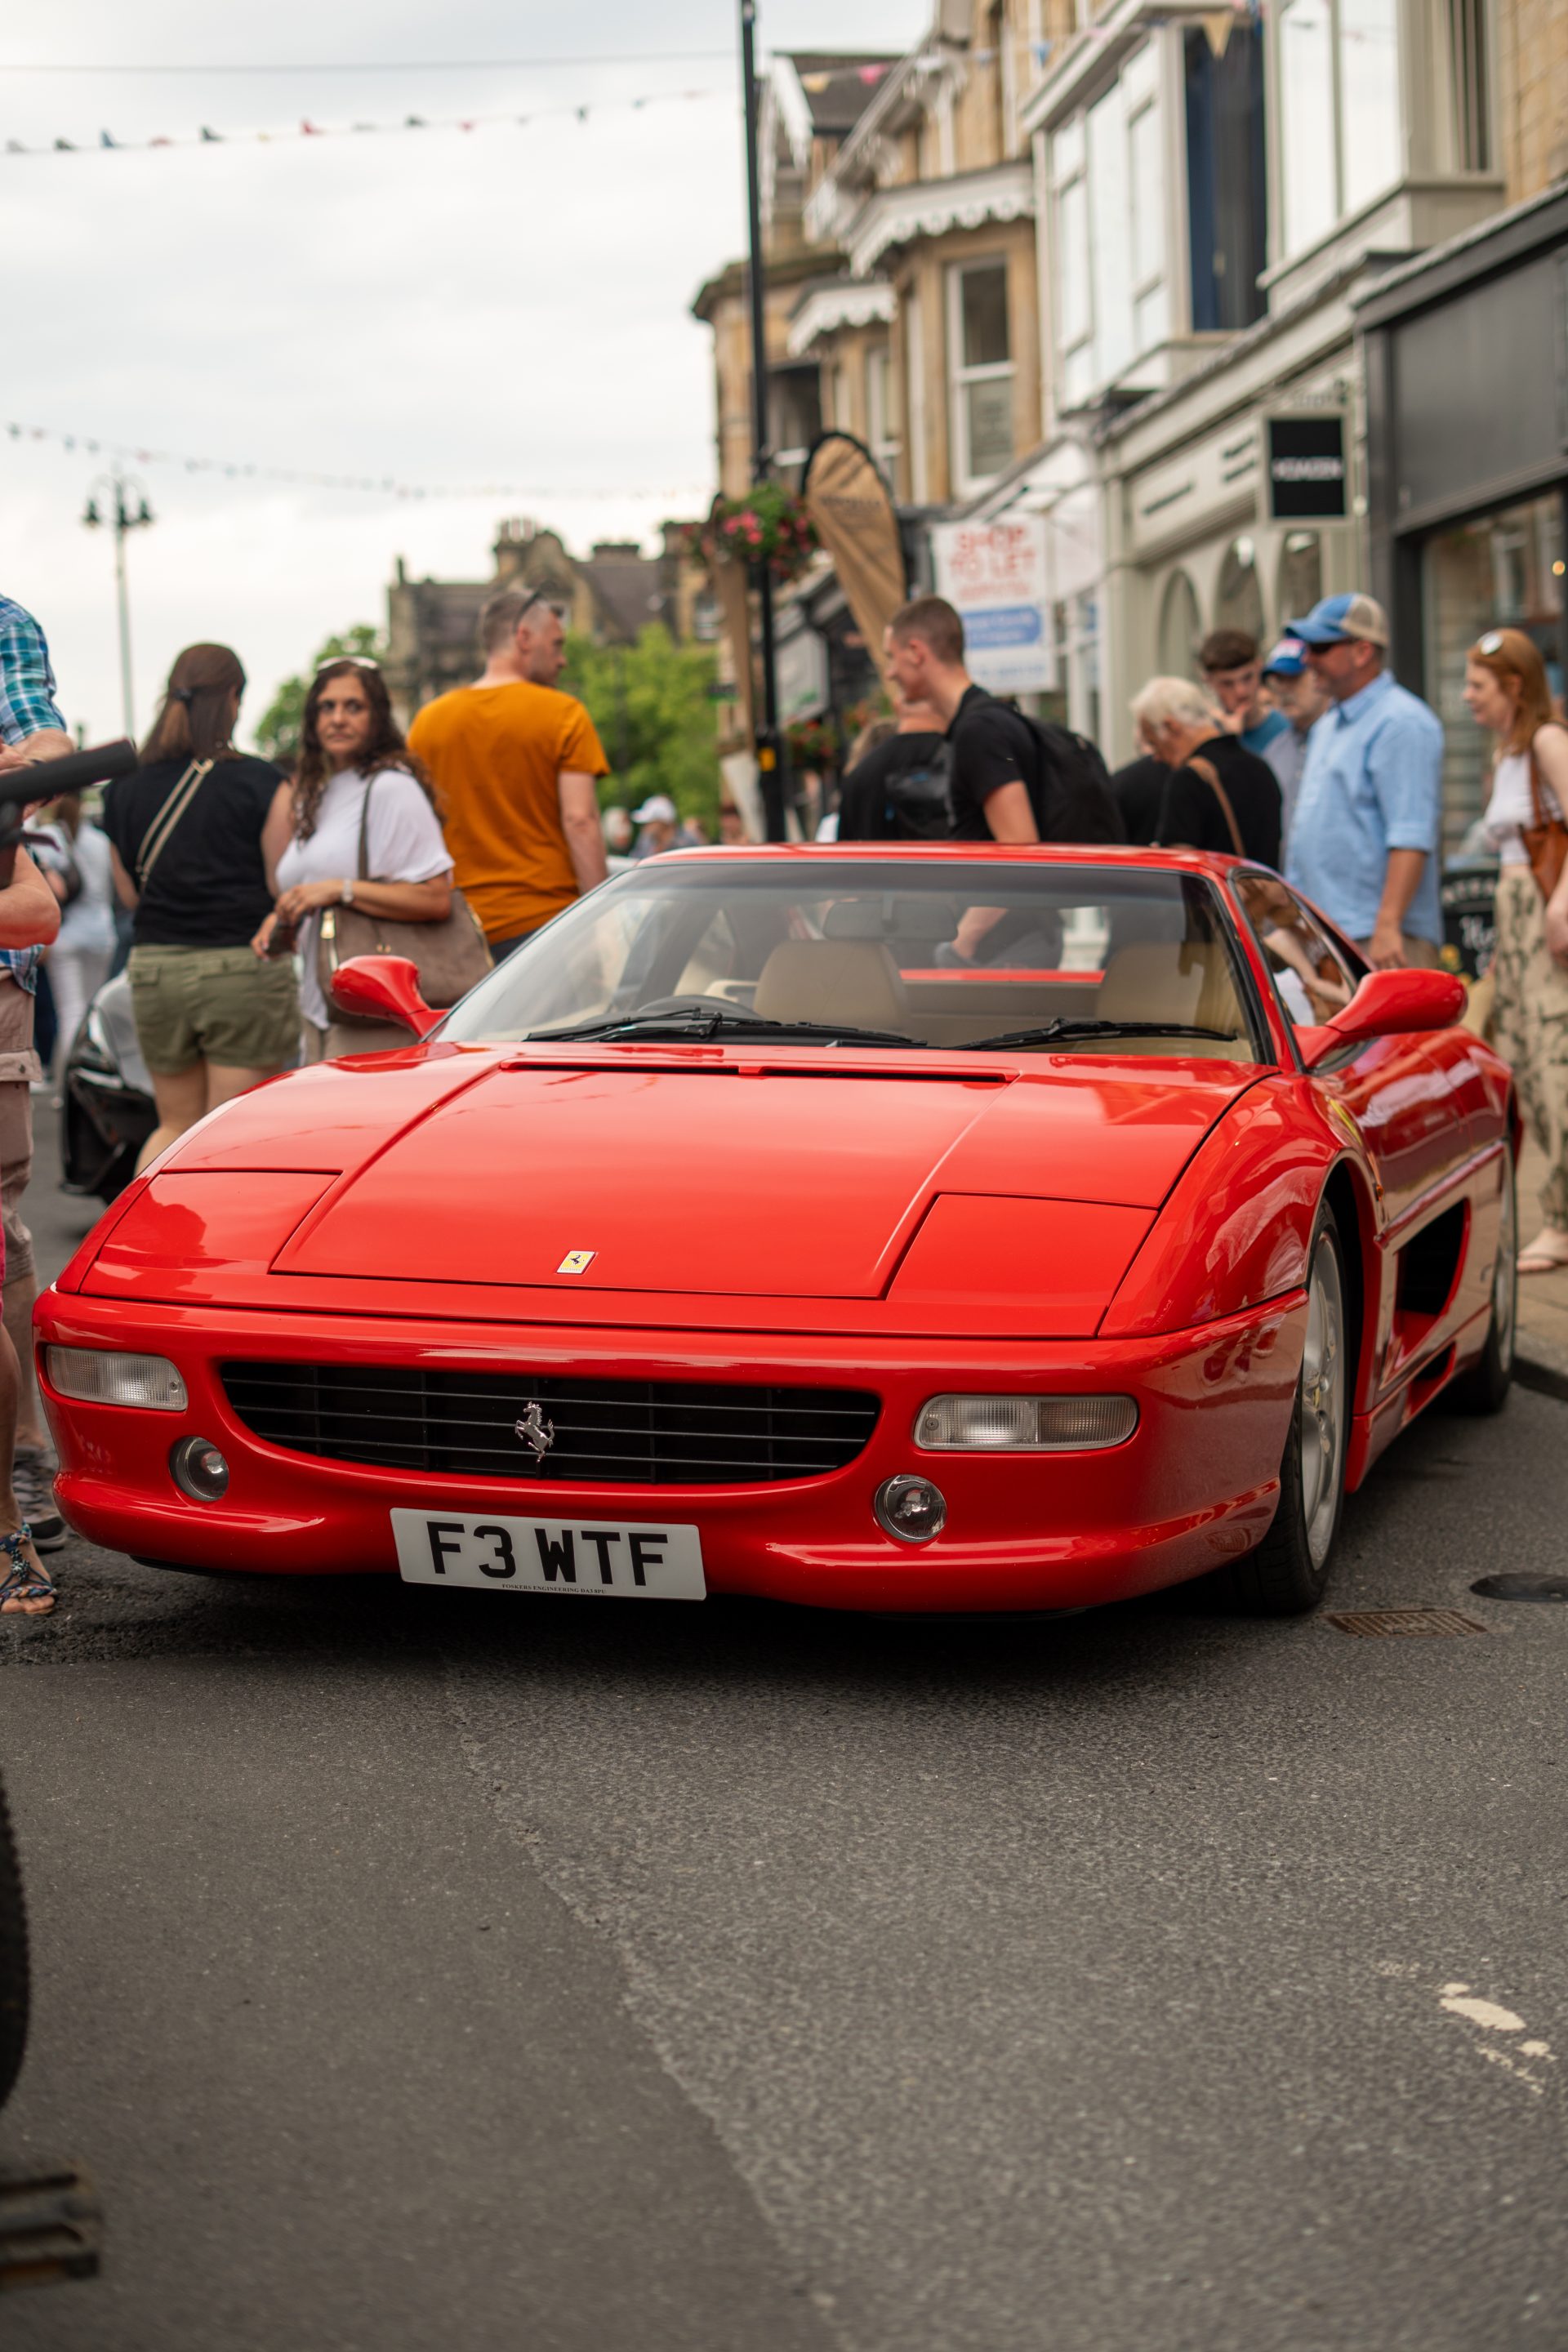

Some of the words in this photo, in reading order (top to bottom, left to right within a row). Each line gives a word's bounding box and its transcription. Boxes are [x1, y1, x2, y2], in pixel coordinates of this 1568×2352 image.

[957, 524, 1027, 555] SHOP
[991, 546, 1036, 576] LET
[426, 1521, 516, 1579] F3
[534, 1528, 668, 1586] WTF
